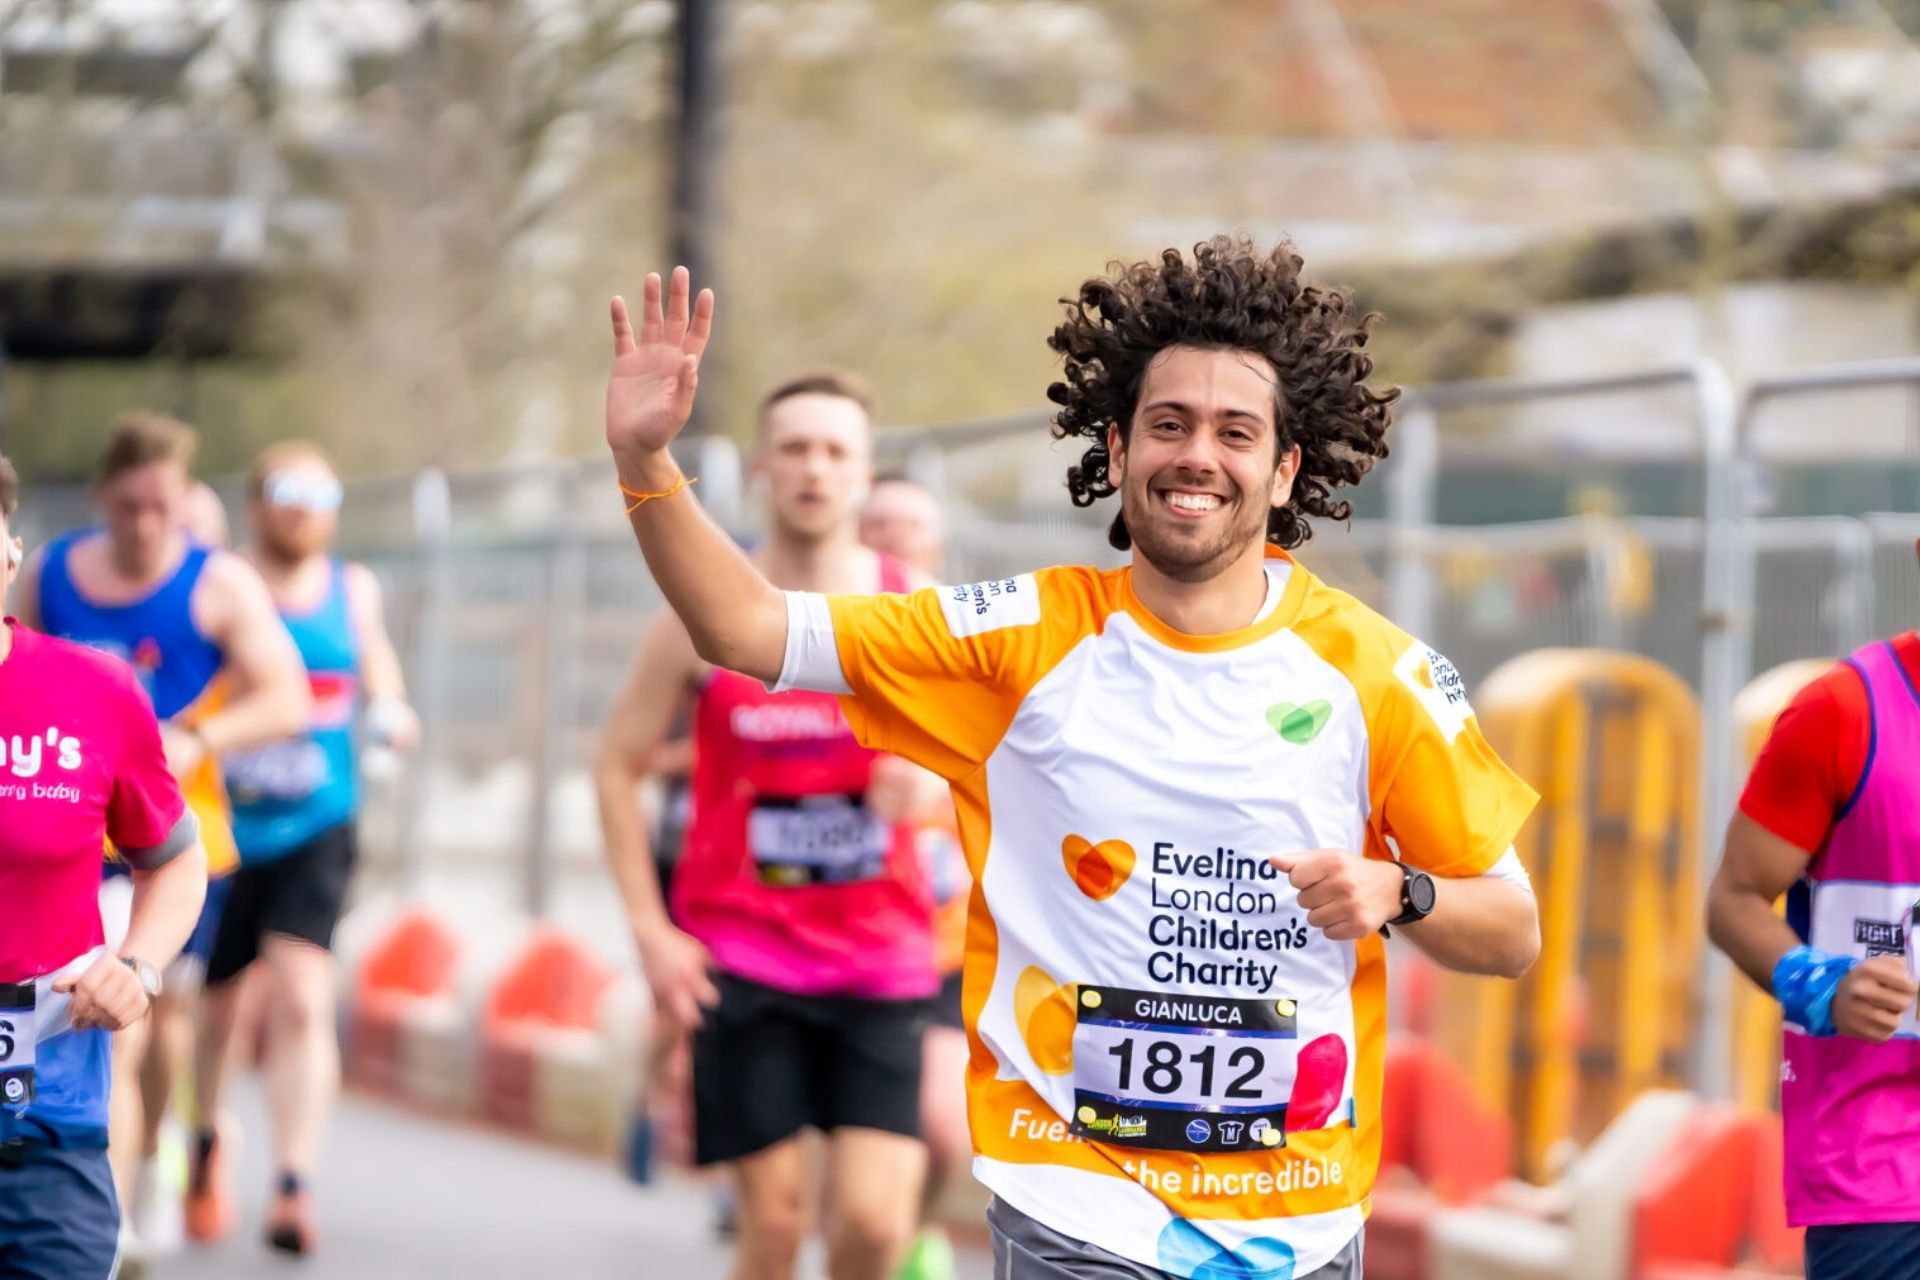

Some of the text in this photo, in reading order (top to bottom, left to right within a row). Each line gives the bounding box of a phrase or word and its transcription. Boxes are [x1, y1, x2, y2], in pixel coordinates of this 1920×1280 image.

[33, 782, 80, 804] baby
[1152, 842, 1277, 881] Evelina
[1151, 877, 1276, 914] London
[1149, 914, 1308, 951] Children's
[1147, 951, 1278, 994] Charity
[1135, 999, 1243, 1024] GIANLUCA
[1108, 1038, 1265, 1099] 1812
[1192, 1156, 1342, 1196] incredible
